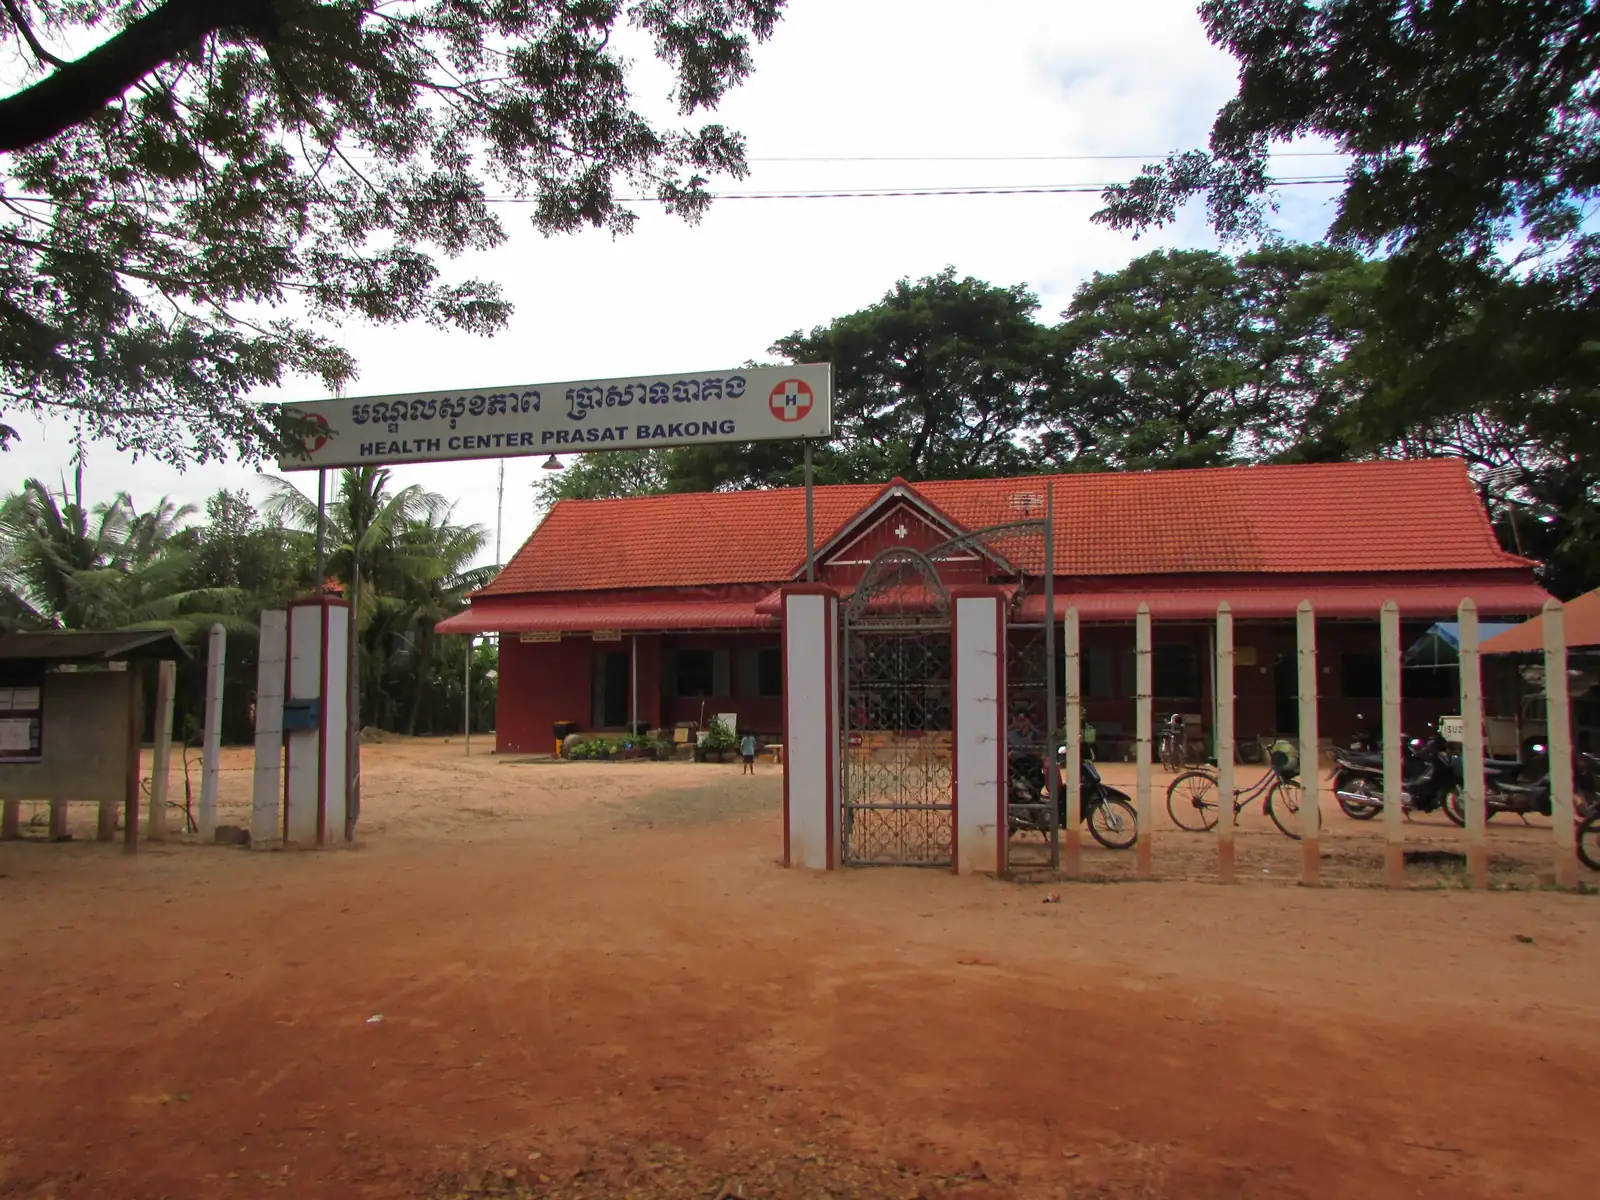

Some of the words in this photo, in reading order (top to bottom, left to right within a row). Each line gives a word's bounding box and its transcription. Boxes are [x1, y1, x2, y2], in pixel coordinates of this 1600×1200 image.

[785, 395, 797, 405] H
[360, 438, 441, 457] HEALTH
[449, 431, 533, 450] CENTER
[541, 426, 628, 444] PRASAT
[636, 420, 735, 440] BAKONG
